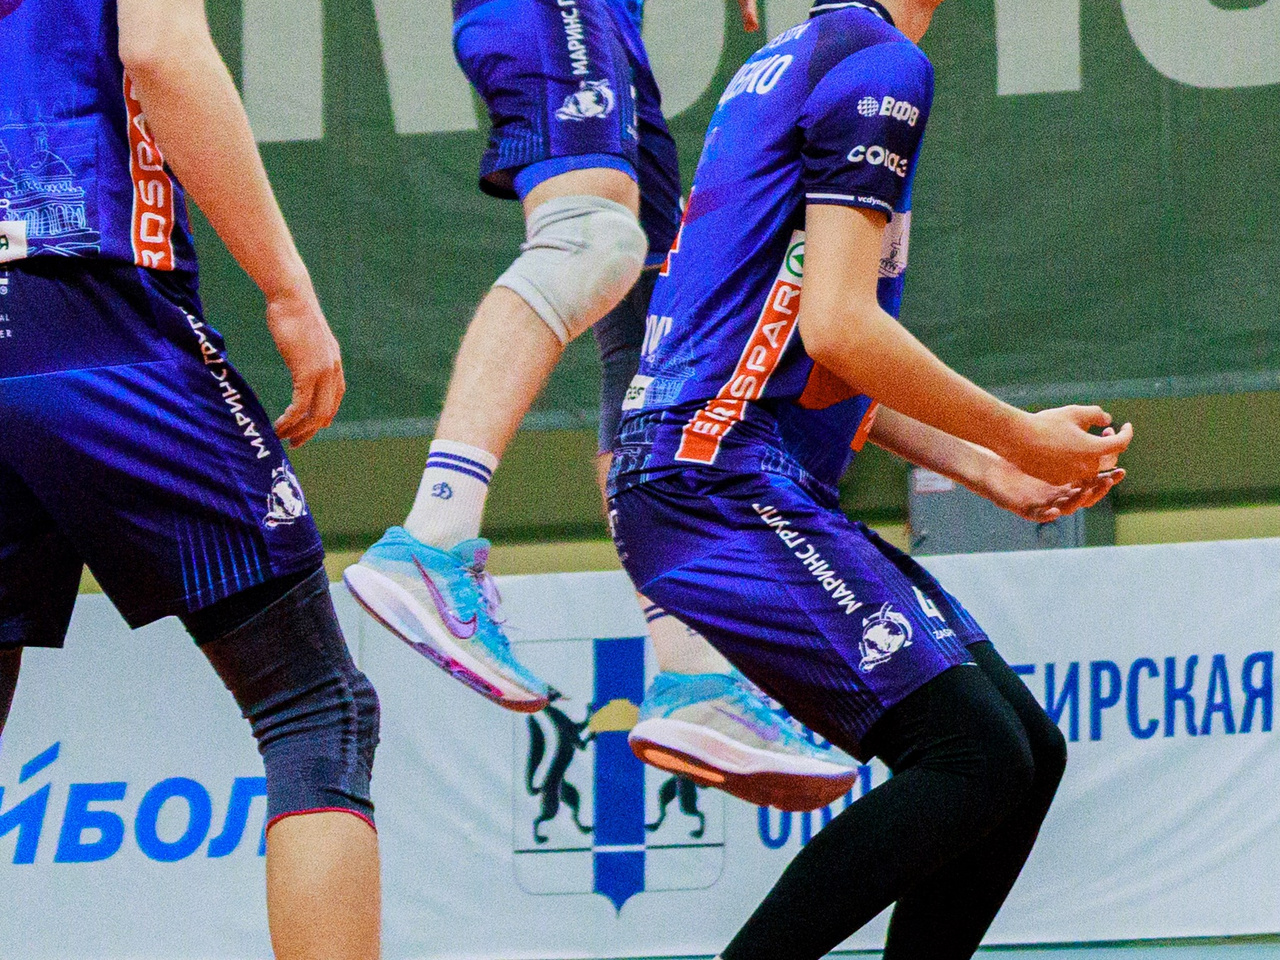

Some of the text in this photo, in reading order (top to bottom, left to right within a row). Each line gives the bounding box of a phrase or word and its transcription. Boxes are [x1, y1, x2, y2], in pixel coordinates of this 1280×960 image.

[561, 7, 590, 76] МАРИНС
[879, 95, 920, 127] ВФВ
[211, 368, 271, 460] МАРИНС
[795, 542, 863, 616] МАРИНС
